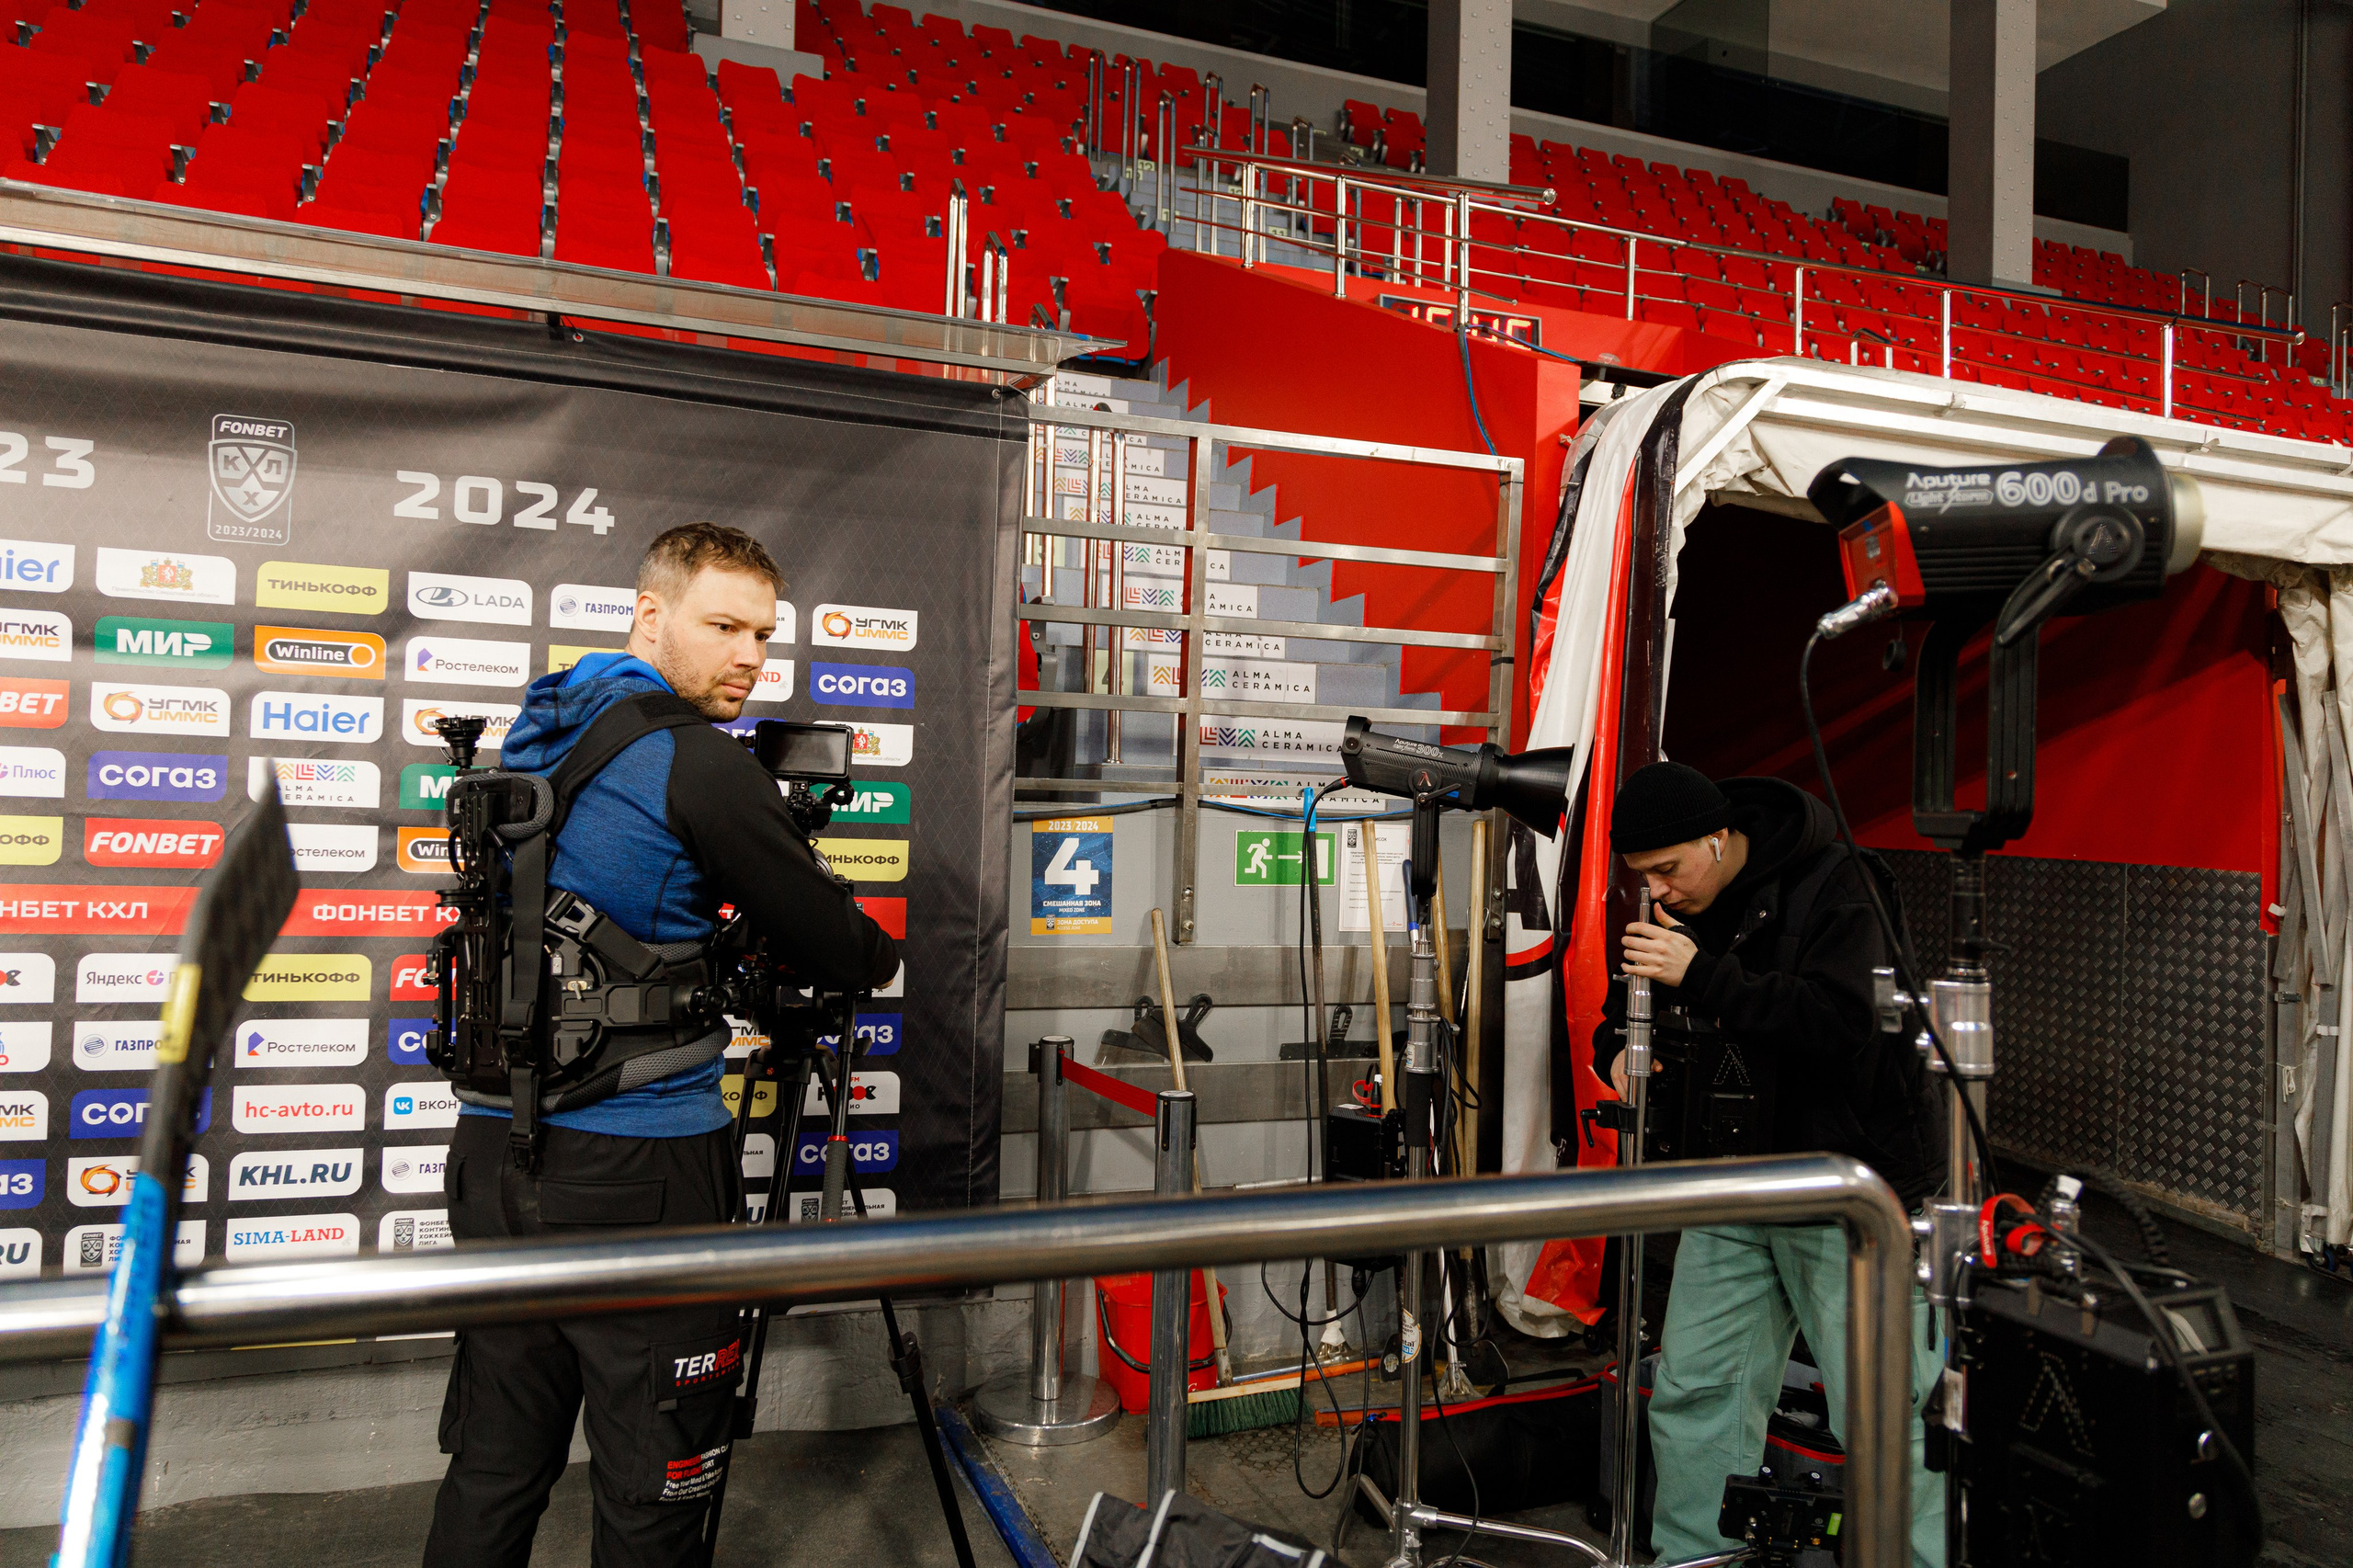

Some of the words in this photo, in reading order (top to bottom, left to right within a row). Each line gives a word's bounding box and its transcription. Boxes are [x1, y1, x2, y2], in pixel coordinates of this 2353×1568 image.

[1065, 401, 1094, 409] ALMA
[220, 420, 288, 438] FONBET
[1126, 483, 1149, 493] LMA
[1905, 472, 1991, 490] Aputure
[2105, 481, 2149, 504] Pro
[393, 470, 615, 535] 2024
[1126, 493, 1182, 504] ERAMICA
[1136, 513, 1169, 522] ALMA
[215, 524, 282, 540] 2023/2024
[1156, 549, 1181, 557] ALM
[0, 549, 60, 583] ier
[267, 578, 378, 597] ТИНЬКОФФ
[474, 594, 525, 609] LADA
[0, 621, 60, 637] ГМК
[856, 618, 908, 631] УГМК
[0, 635, 61, 648] MMC
[855, 629, 909, 641] UMMC
[117, 628, 212, 657] МИР
[1205, 640, 1280, 651] CERAMICA
[275, 643, 346, 661] Winline
[436, 659, 519, 675] Ростелеком
[1233, 670, 1271, 680] ALMA
[1232, 681, 1311, 692] CERAMICA
[148, 698, 219, 712] УГМК
[147, 710, 219, 723] UMMC
[262, 701, 370, 734] Haier
[1262, 730, 1302, 740] ALMA
[13, 765, 57, 779] Плюс
[285, 793, 355, 802] ERAMICA
[1048, 821, 1099, 831] 2023/2024
[89, 832, 220, 855] FONBET
[290, 847, 365, 858] стелеком
[825, 854, 900, 865] ИНЬКОФФ
[1044, 837, 1099, 895] 4
[87, 902, 148, 919] КХЛ
[313, 903, 429, 922] ФОНБЕТ
[85, 970, 143, 985] Яндекс
[253, 972, 360, 983] ТИНЬКОФФ
[267, 1041, 356, 1053] Ростелеком
[244, 1101, 354, 1119] hc-avto.ru
[238, 1162, 353, 1187] KHL.RU
[233, 1227, 345, 1245] SIMA-LAND
[666, 1471, 683, 1480] FOR
[665, 1480, 680, 1489] Free
[663, 1488, 678, 1496] From
